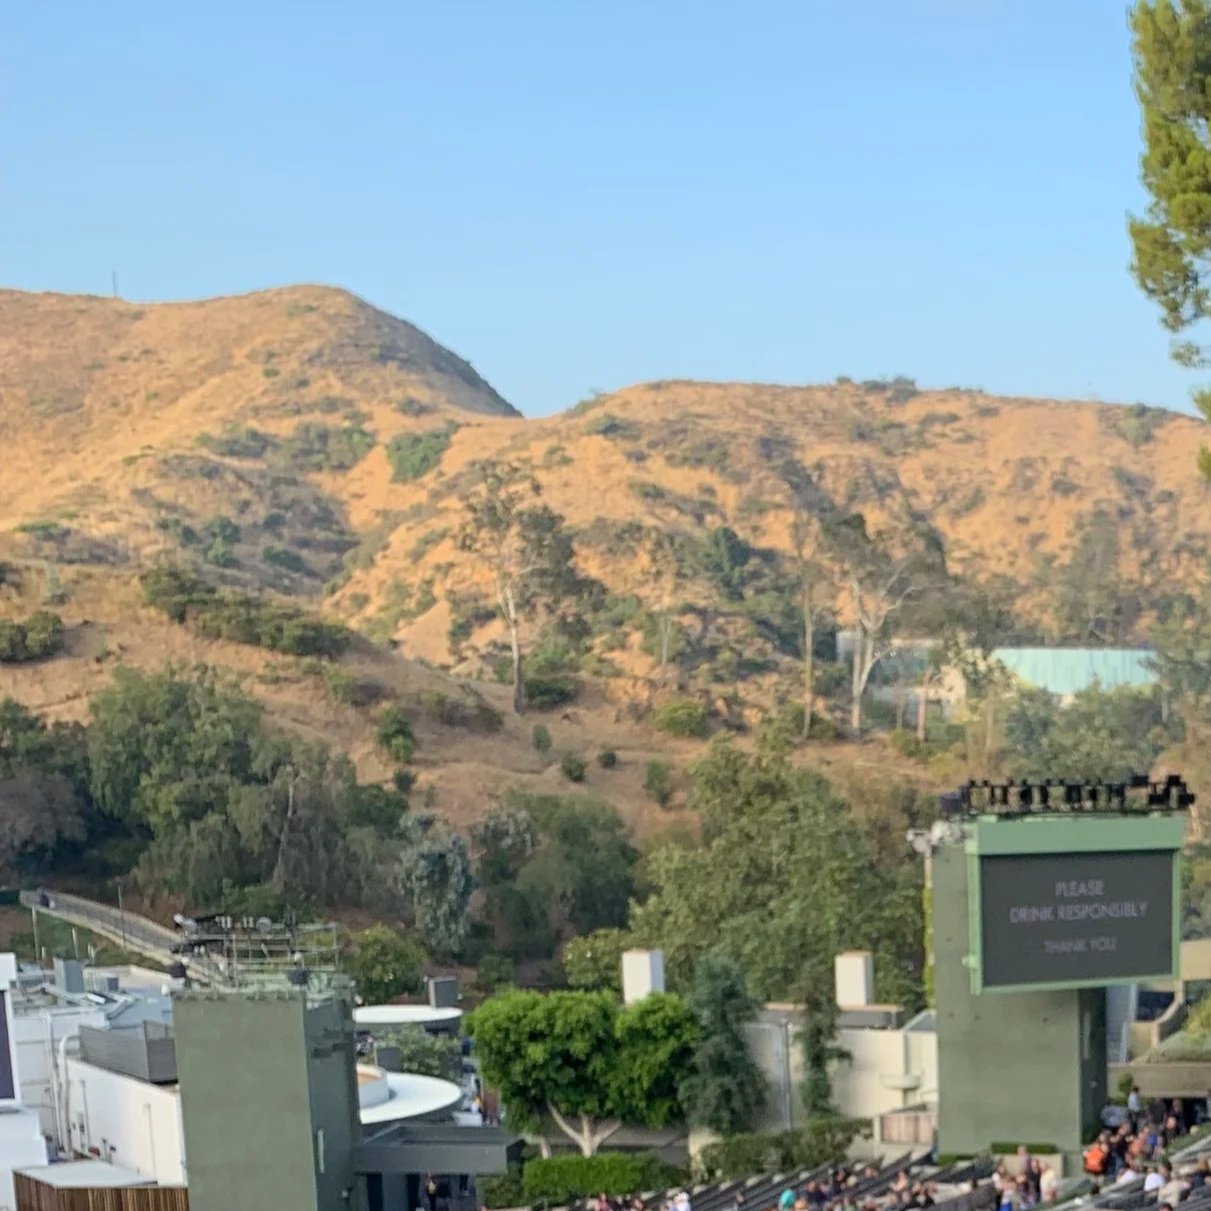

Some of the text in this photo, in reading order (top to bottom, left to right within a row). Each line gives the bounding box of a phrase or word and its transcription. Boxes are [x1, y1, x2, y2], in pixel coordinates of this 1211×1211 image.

[1055, 879, 1104, 897] PLEASE
[1009, 901, 1148, 923] DRINK RESPONSIBLY
[1044, 936, 1118, 953] THANK YOU
